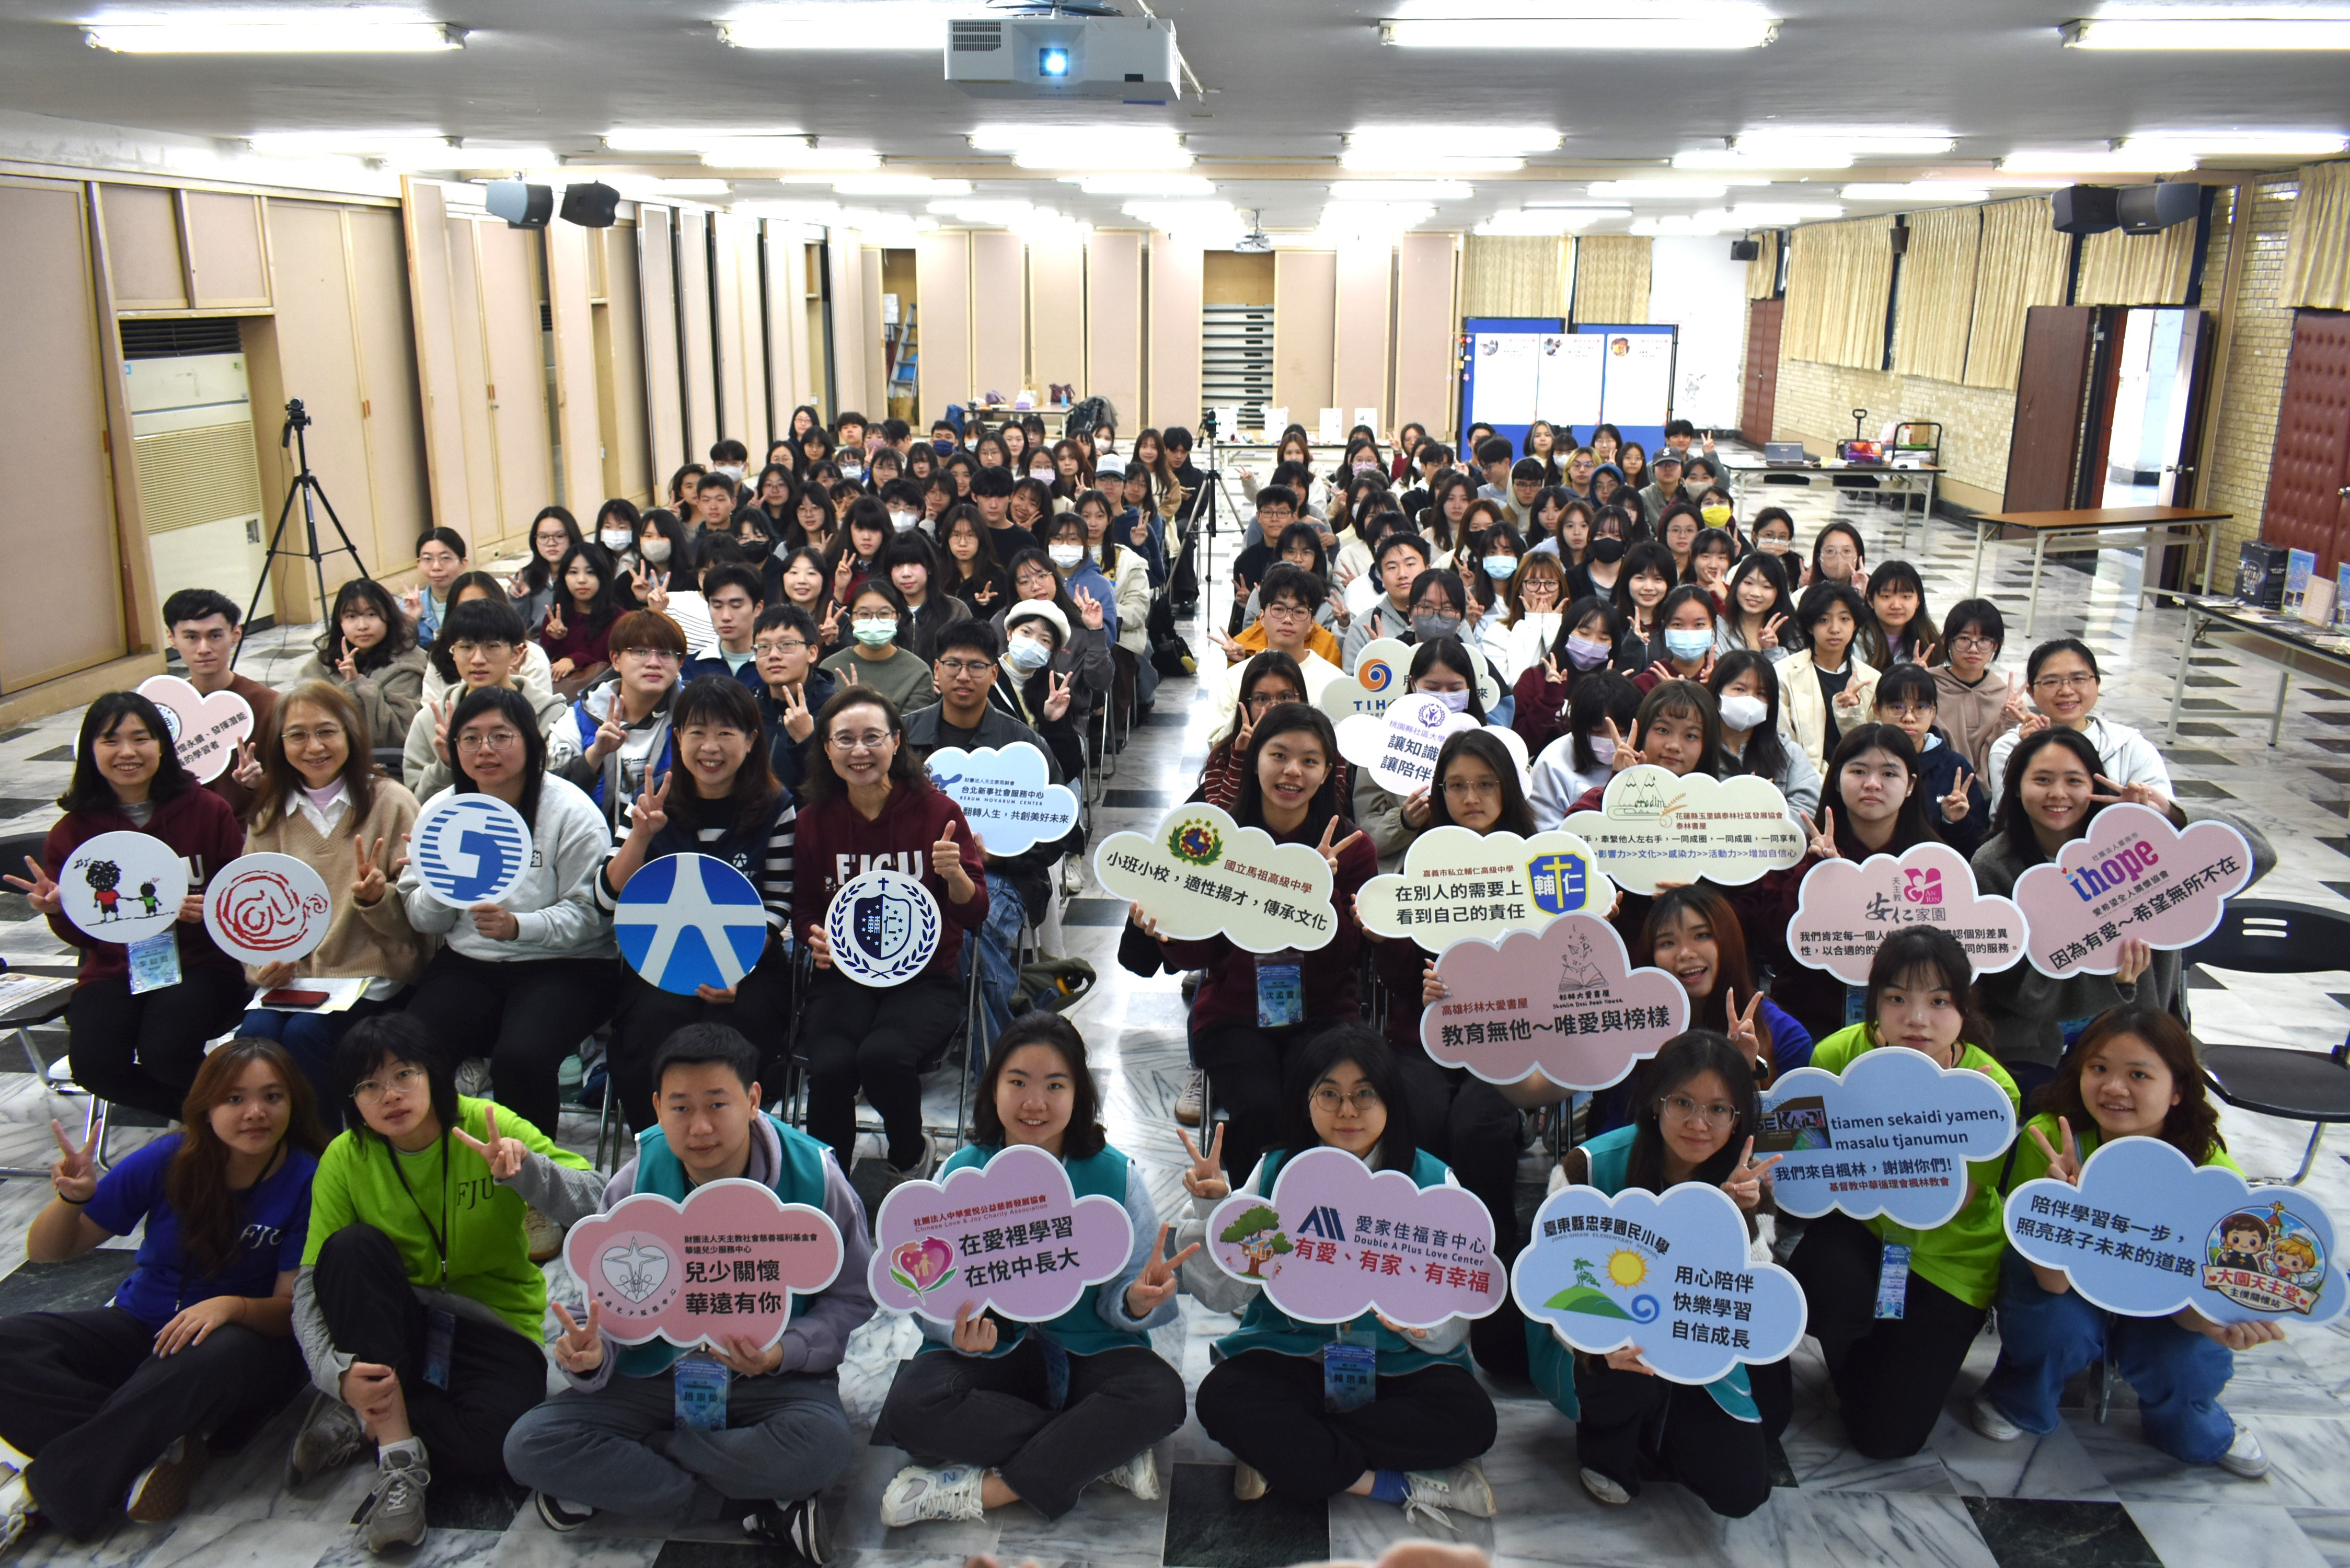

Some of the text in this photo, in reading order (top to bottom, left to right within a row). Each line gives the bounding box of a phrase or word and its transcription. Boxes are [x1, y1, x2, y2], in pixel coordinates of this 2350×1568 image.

[1663, 448, 1670, 456] S
[1353, 699, 1396, 711] TIH
[176, 712, 247, 755] 懷永續、發揮潛能
[1388, 734, 1439, 762] 讓知識
[961, 786, 1044, 799] 台北新事社會服務中心
[963, 807, 1069, 824] 翻轉人生，共創美好未來
[1224, 858, 1312, 894] 國立馬祖高級中學
[1533, 872, 1585, 897] 輔仁
[1892, 877, 1902, 902] 天主教
[1106, 850, 1328, 931] 小班小校，適性揚才，傳承文化
[1395, 880, 1524, 903] 在別人的需要上
[867, 916, 897, 935] 輔仁
[1396, 903, 1526, 926] 看到自己的責任
[1442, 998, 1528, 1017] 高雄杉林大愛書屋
[1830, 1108, 2005, 1130] tiamen sekaidi yamen,
[1836, 1133, 1968, 1151] masalu tjanumun
[457, 1174, 494, 1210] FJU
[915, 1224, 942, 1232] Chinese
[984, 1210, 1008, 1220] Charity
[1010, 1204, 1048, 1215] Association
[958, 1215, 1074, 1257] 在愛裡學習
[1355, 1215, 1486, 1254] 愛家佳福音中心
[1543, 1215, 1670, 1255] 臺東縣忠孝國民小學
[2015, 1217, 2196, 1277] 照亮孩子未來的道路
[1354, 1234, 1388, 1249] Double
[1401, 1244, 1422, 1254] Plus
[1426, 1248, 1448, 1259] Love
[1452, 1253, 1484, 1266] Center
[1636, 1243, 1659, 1260] SCHOOL
[685, 1259, 780, 1284] 兒少關懷
[964, 1247, 1080, 1288] 在悅中長大
[1294, 1237, 1491, 1294] 有愛、有家、有幸福
[1674, 1265, 1754, 1294] 用心陪伴
[685, 1292, 782, 1316] 華遠有你
[1673, 1291, 1752, 1321] 快樂學習
[1672, 1320, 1750, 1350] 自信成長
